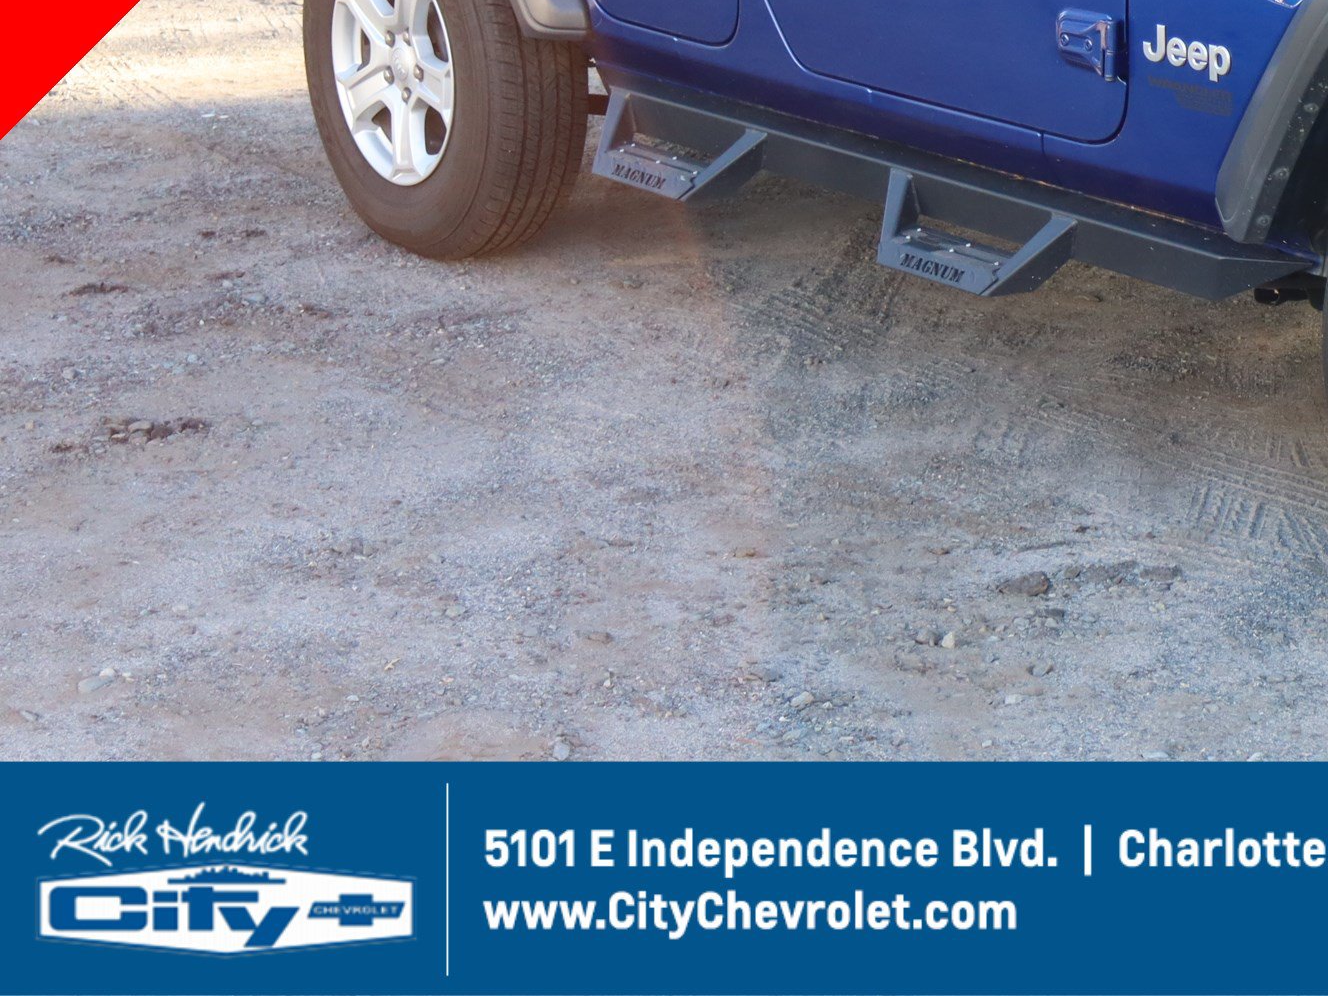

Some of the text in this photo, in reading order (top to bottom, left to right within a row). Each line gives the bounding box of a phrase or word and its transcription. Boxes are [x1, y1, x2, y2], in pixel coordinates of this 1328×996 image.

[1142, 24, 1232, 83] Jeep
[611, 164, 667, 190] MAGNUM
[900, 253, 965, 283] MAGNUM
